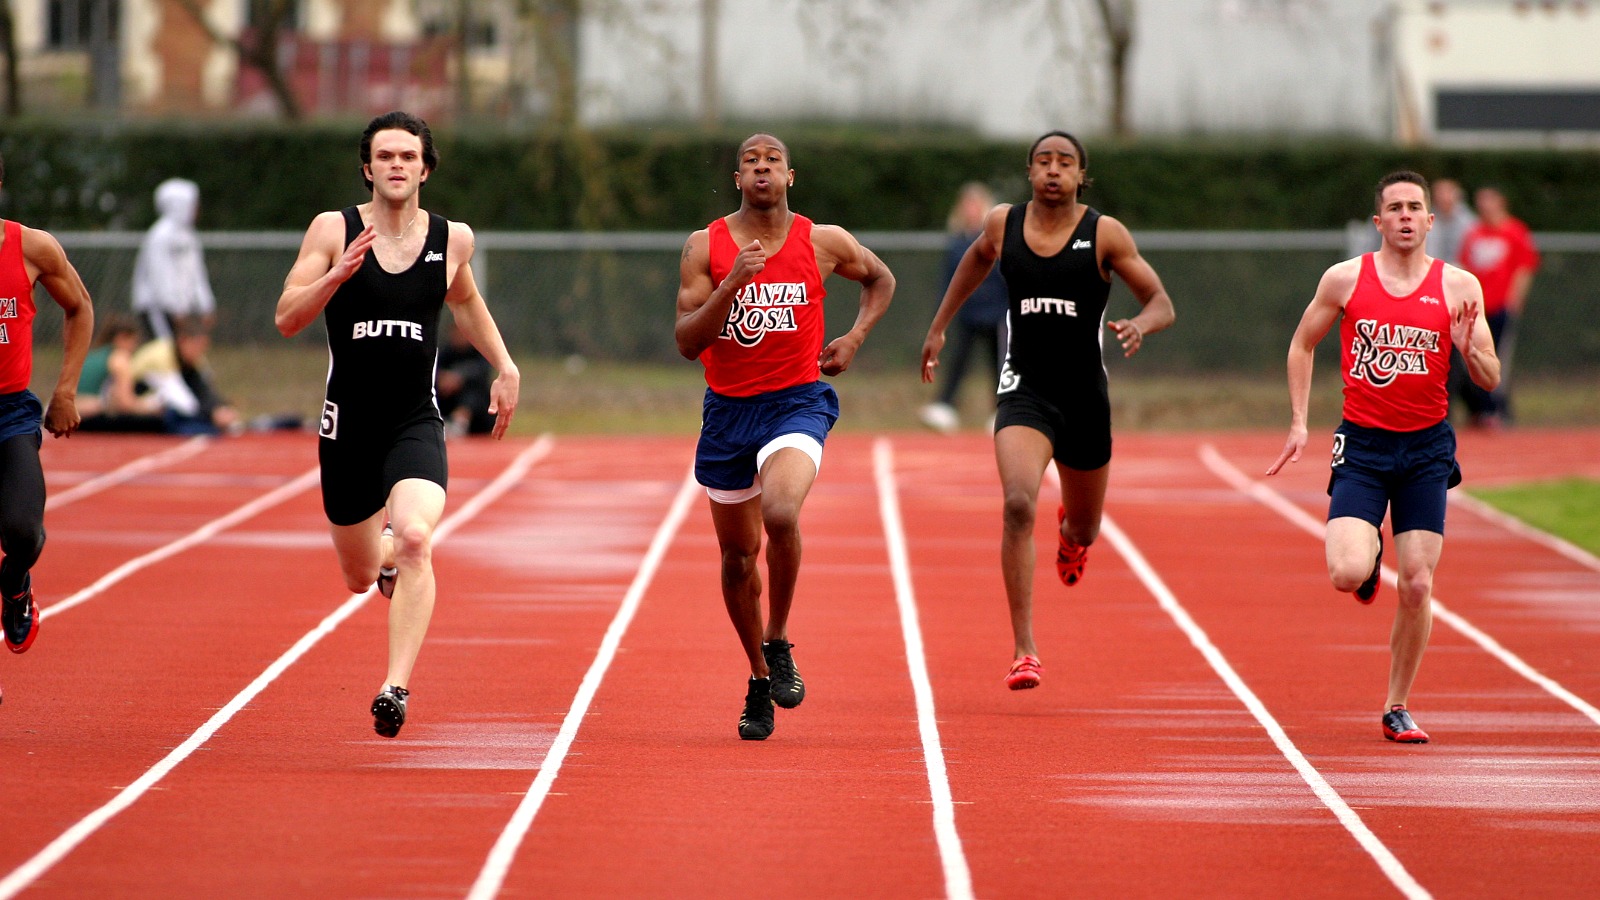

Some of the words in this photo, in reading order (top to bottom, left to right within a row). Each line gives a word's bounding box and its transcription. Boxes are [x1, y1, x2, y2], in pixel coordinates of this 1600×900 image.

[732, 282, 809, 308] ANTA
[1020, 297, 1078, 318] BUTTE
[352, 319, 423, 342] BUTTE
[1000, 368, 1015, 390] 3
[320, 402, 334, 436] 5
